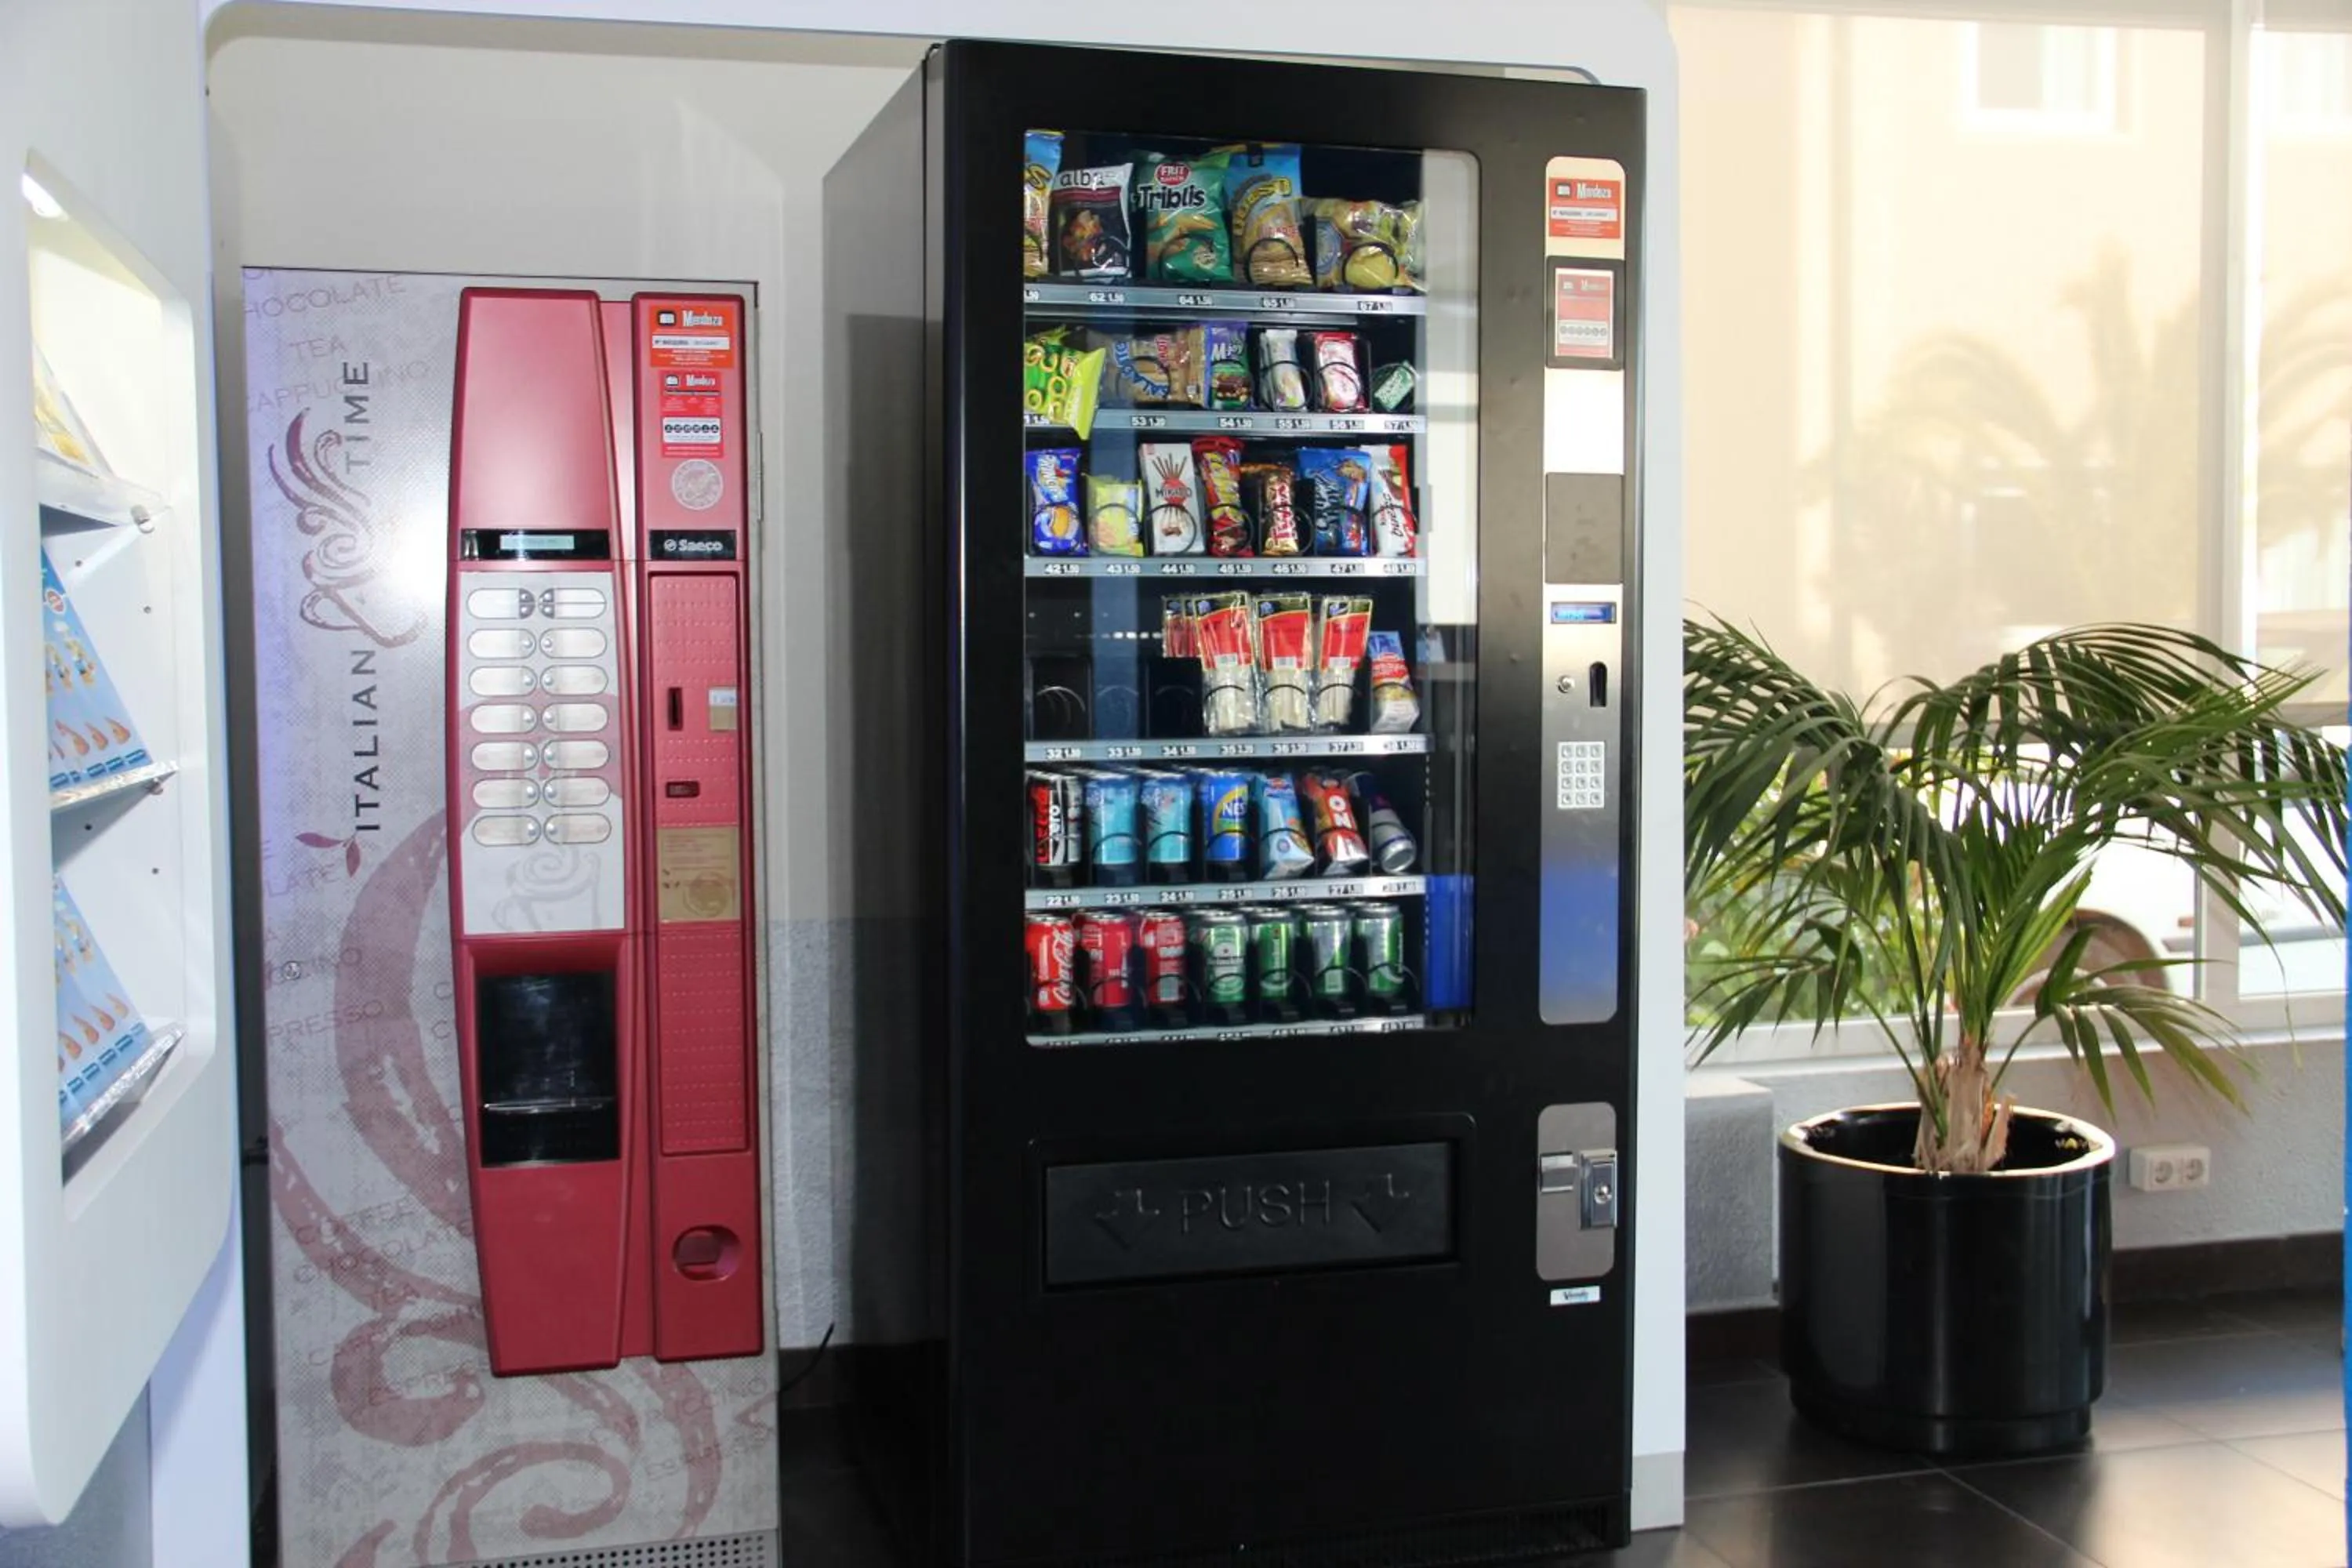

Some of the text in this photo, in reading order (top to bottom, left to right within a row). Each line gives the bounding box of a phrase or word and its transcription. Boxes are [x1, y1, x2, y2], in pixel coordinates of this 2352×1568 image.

[1139, 184, 1206, 210] Triblis
[343, 361, 371, 475] TIME
[678, 539, 723, 551] Saeco
[1045, 564, 1062, 574] 42
[1162, 564, 1177, 574] 44
[350, 650, 380, 831] ITALIAN
[1178, 1178, 1332, 1235] PUSH
